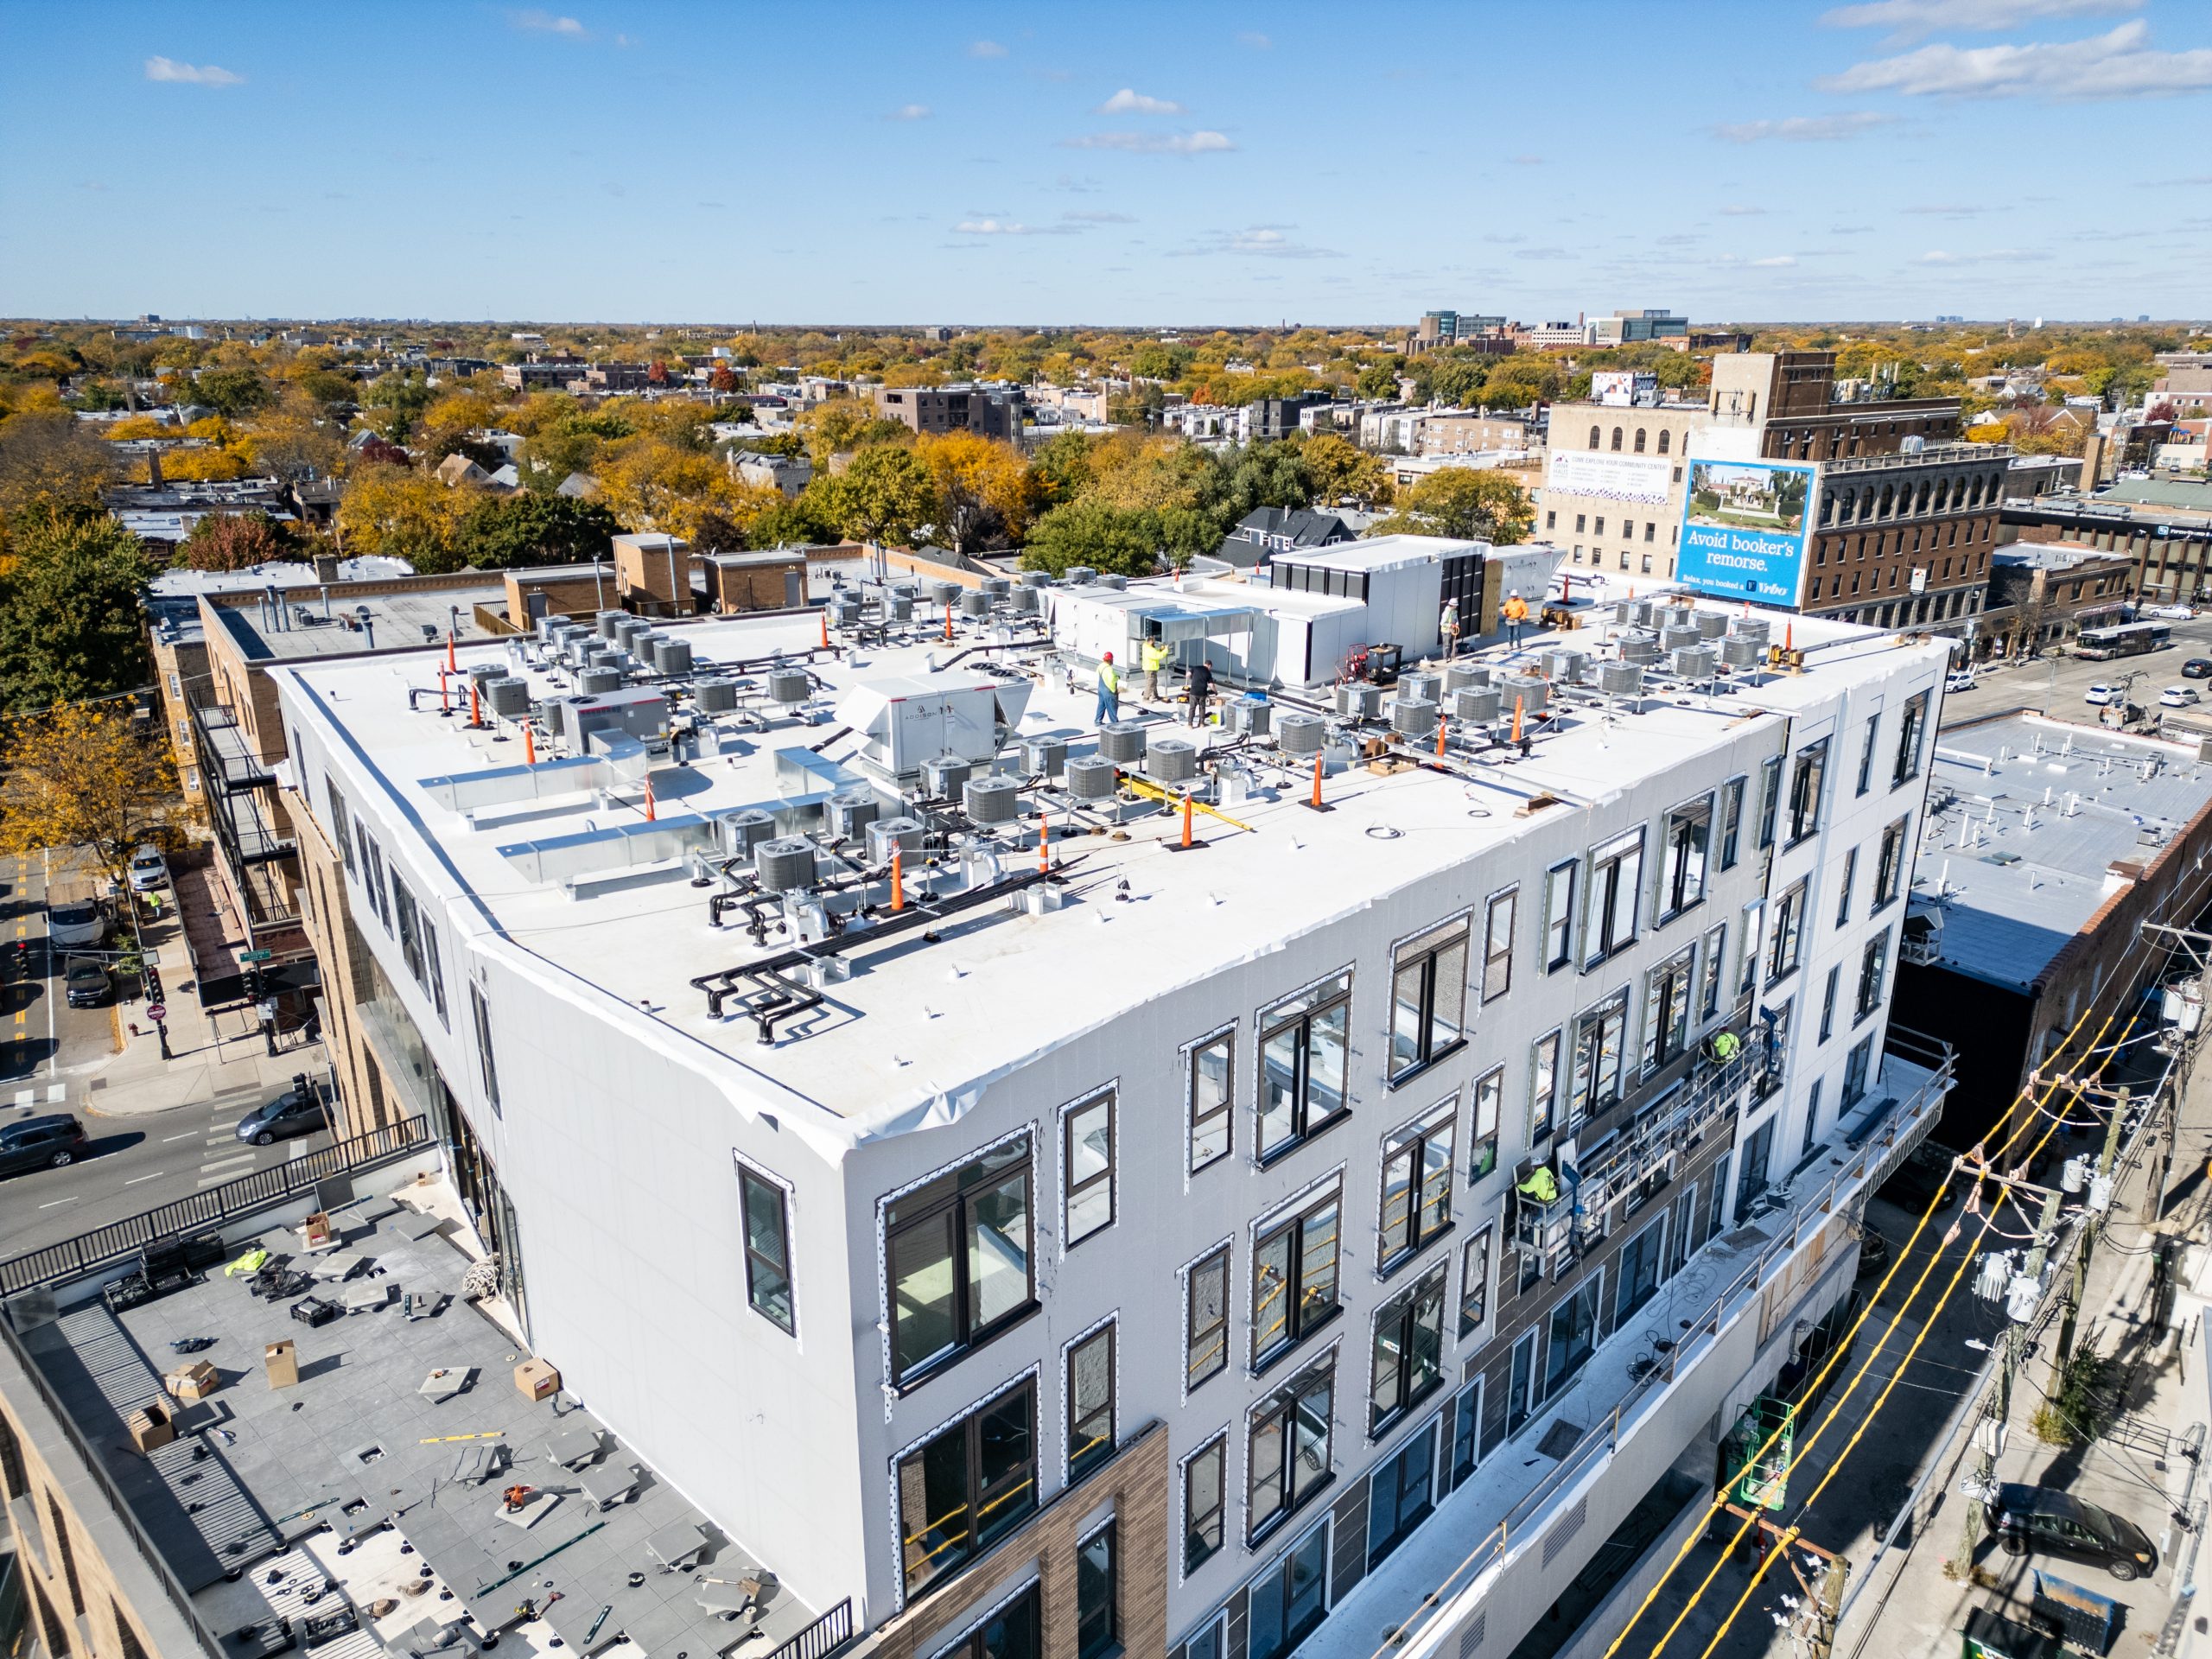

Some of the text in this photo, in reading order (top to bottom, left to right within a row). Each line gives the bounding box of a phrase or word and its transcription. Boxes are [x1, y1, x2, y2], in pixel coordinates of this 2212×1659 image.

[1619, 461, 1646, 469] COMMUNITY
[1687, 530, 1795, 557] Avoid booker's
[1706, 552, 1768, 572] remorse.
[1682, 574, 1701, 584] Relax,
[1715, 579, 1738, 589] booked
[1758, 582, 1789, 596] Vrbo
